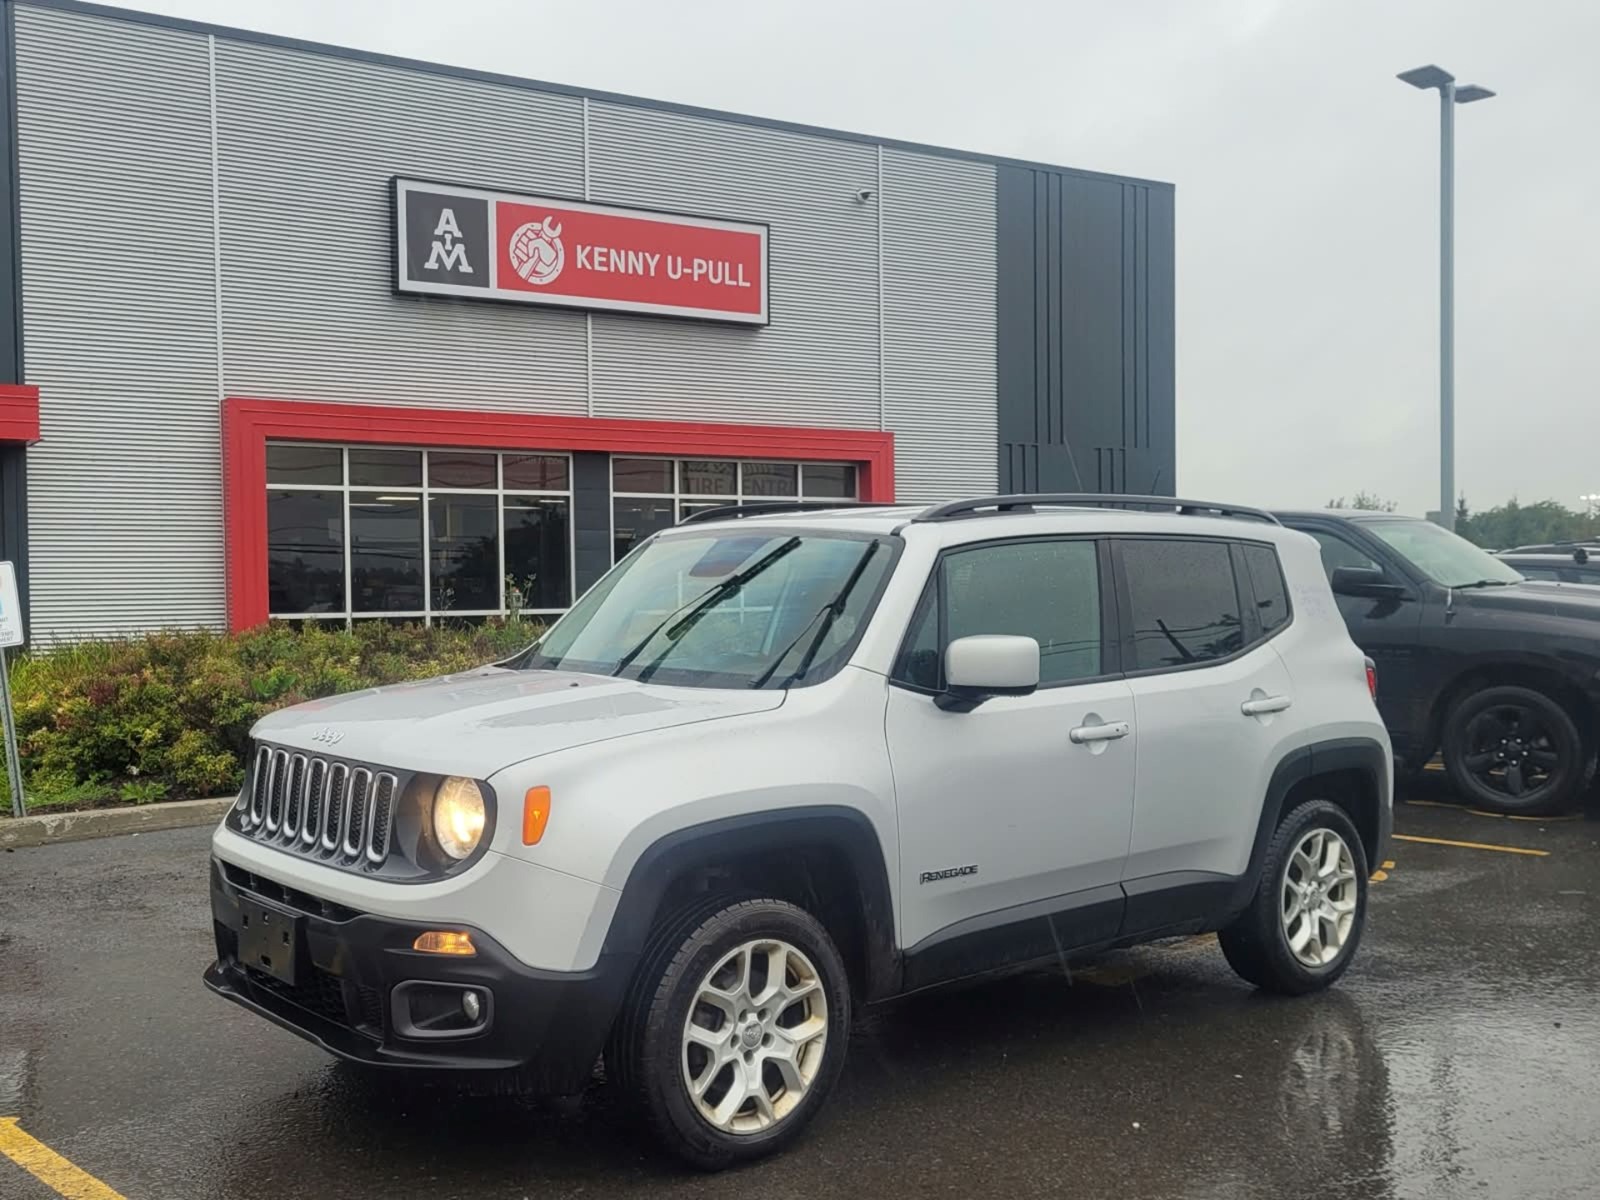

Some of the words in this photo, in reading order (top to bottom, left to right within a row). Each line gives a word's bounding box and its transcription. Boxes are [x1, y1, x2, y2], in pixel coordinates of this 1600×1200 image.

[576, 244, 661, 277] KENNY
[667, 255, 751, 287] U-PULL
[919, 864, 979, 885] RENEGADE
